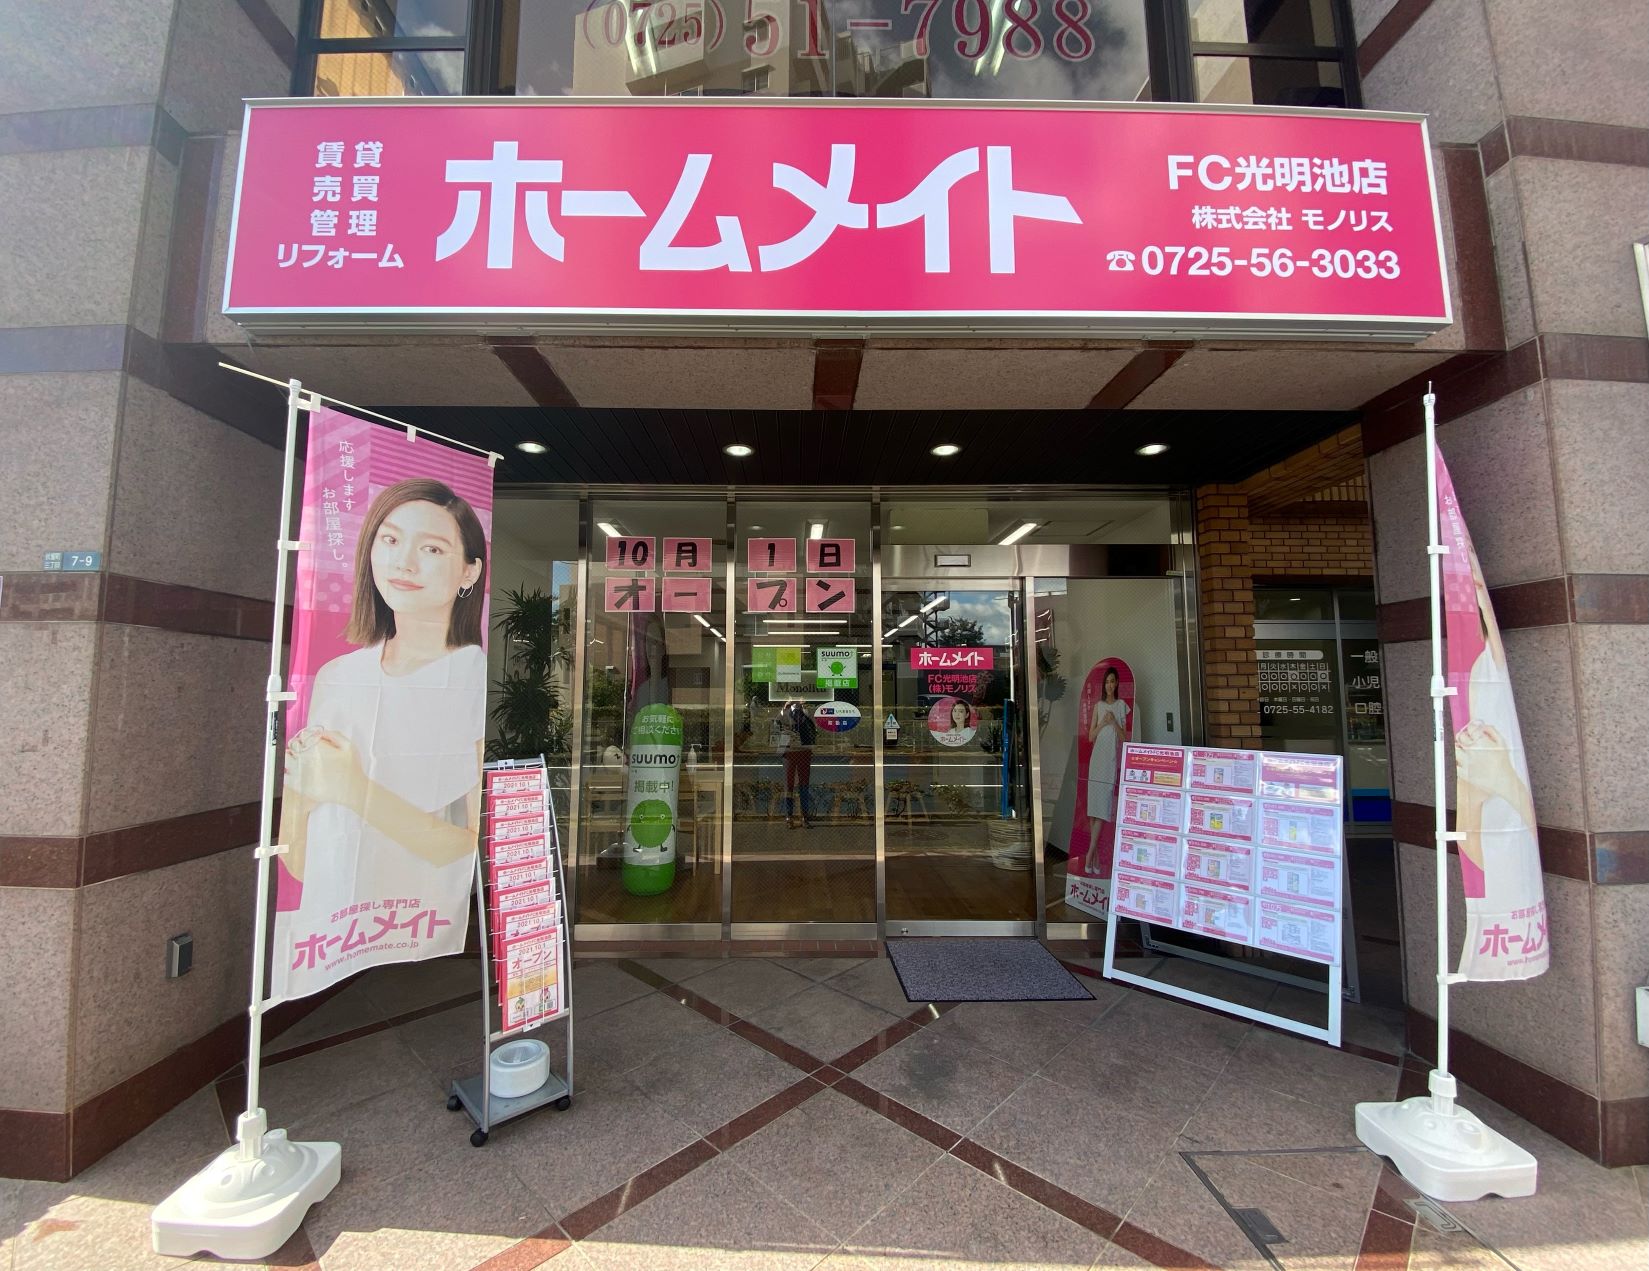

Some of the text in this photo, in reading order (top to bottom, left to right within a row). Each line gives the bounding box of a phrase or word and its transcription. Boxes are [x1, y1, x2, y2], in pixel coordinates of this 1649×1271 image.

[316, 140, 383, 170] 賃貸
[312, 174, 381, 203] 売買
[1167, 155, 1388, 196] FC光明池店
[435, 140, 1084, 274] ホームメイト
[1191, 205, 1394, 234] 株式会社 モノリス
[309, 209, 378, 238] 管理
[276, 242, 405, 270] リフォーム
[1141, 246, 1401, 280] 0725-56-3033
[338, 439, 356, 512] 応援します
[71, 555, 93, 567] 7-9
[614, 578, 846, 611] オープン
[821, 649, 850, 657] suumo
[918, 651, 985, 667] ホームメイト
[1350, 651, 1378, 663] 一般
[927, 674, 977, 684] FC光明池店
[928, 684, 977, 694] (株)モノリス
[1352, 675, 1380, 689] 小児
[1263, 705, 1334, 714] 0725-55-4182
[631, 753, 676, 765] suumo
[291, 909, 452, 971] ホームメイト
[324, 940, 419, 971] www.homemate.co.jp
